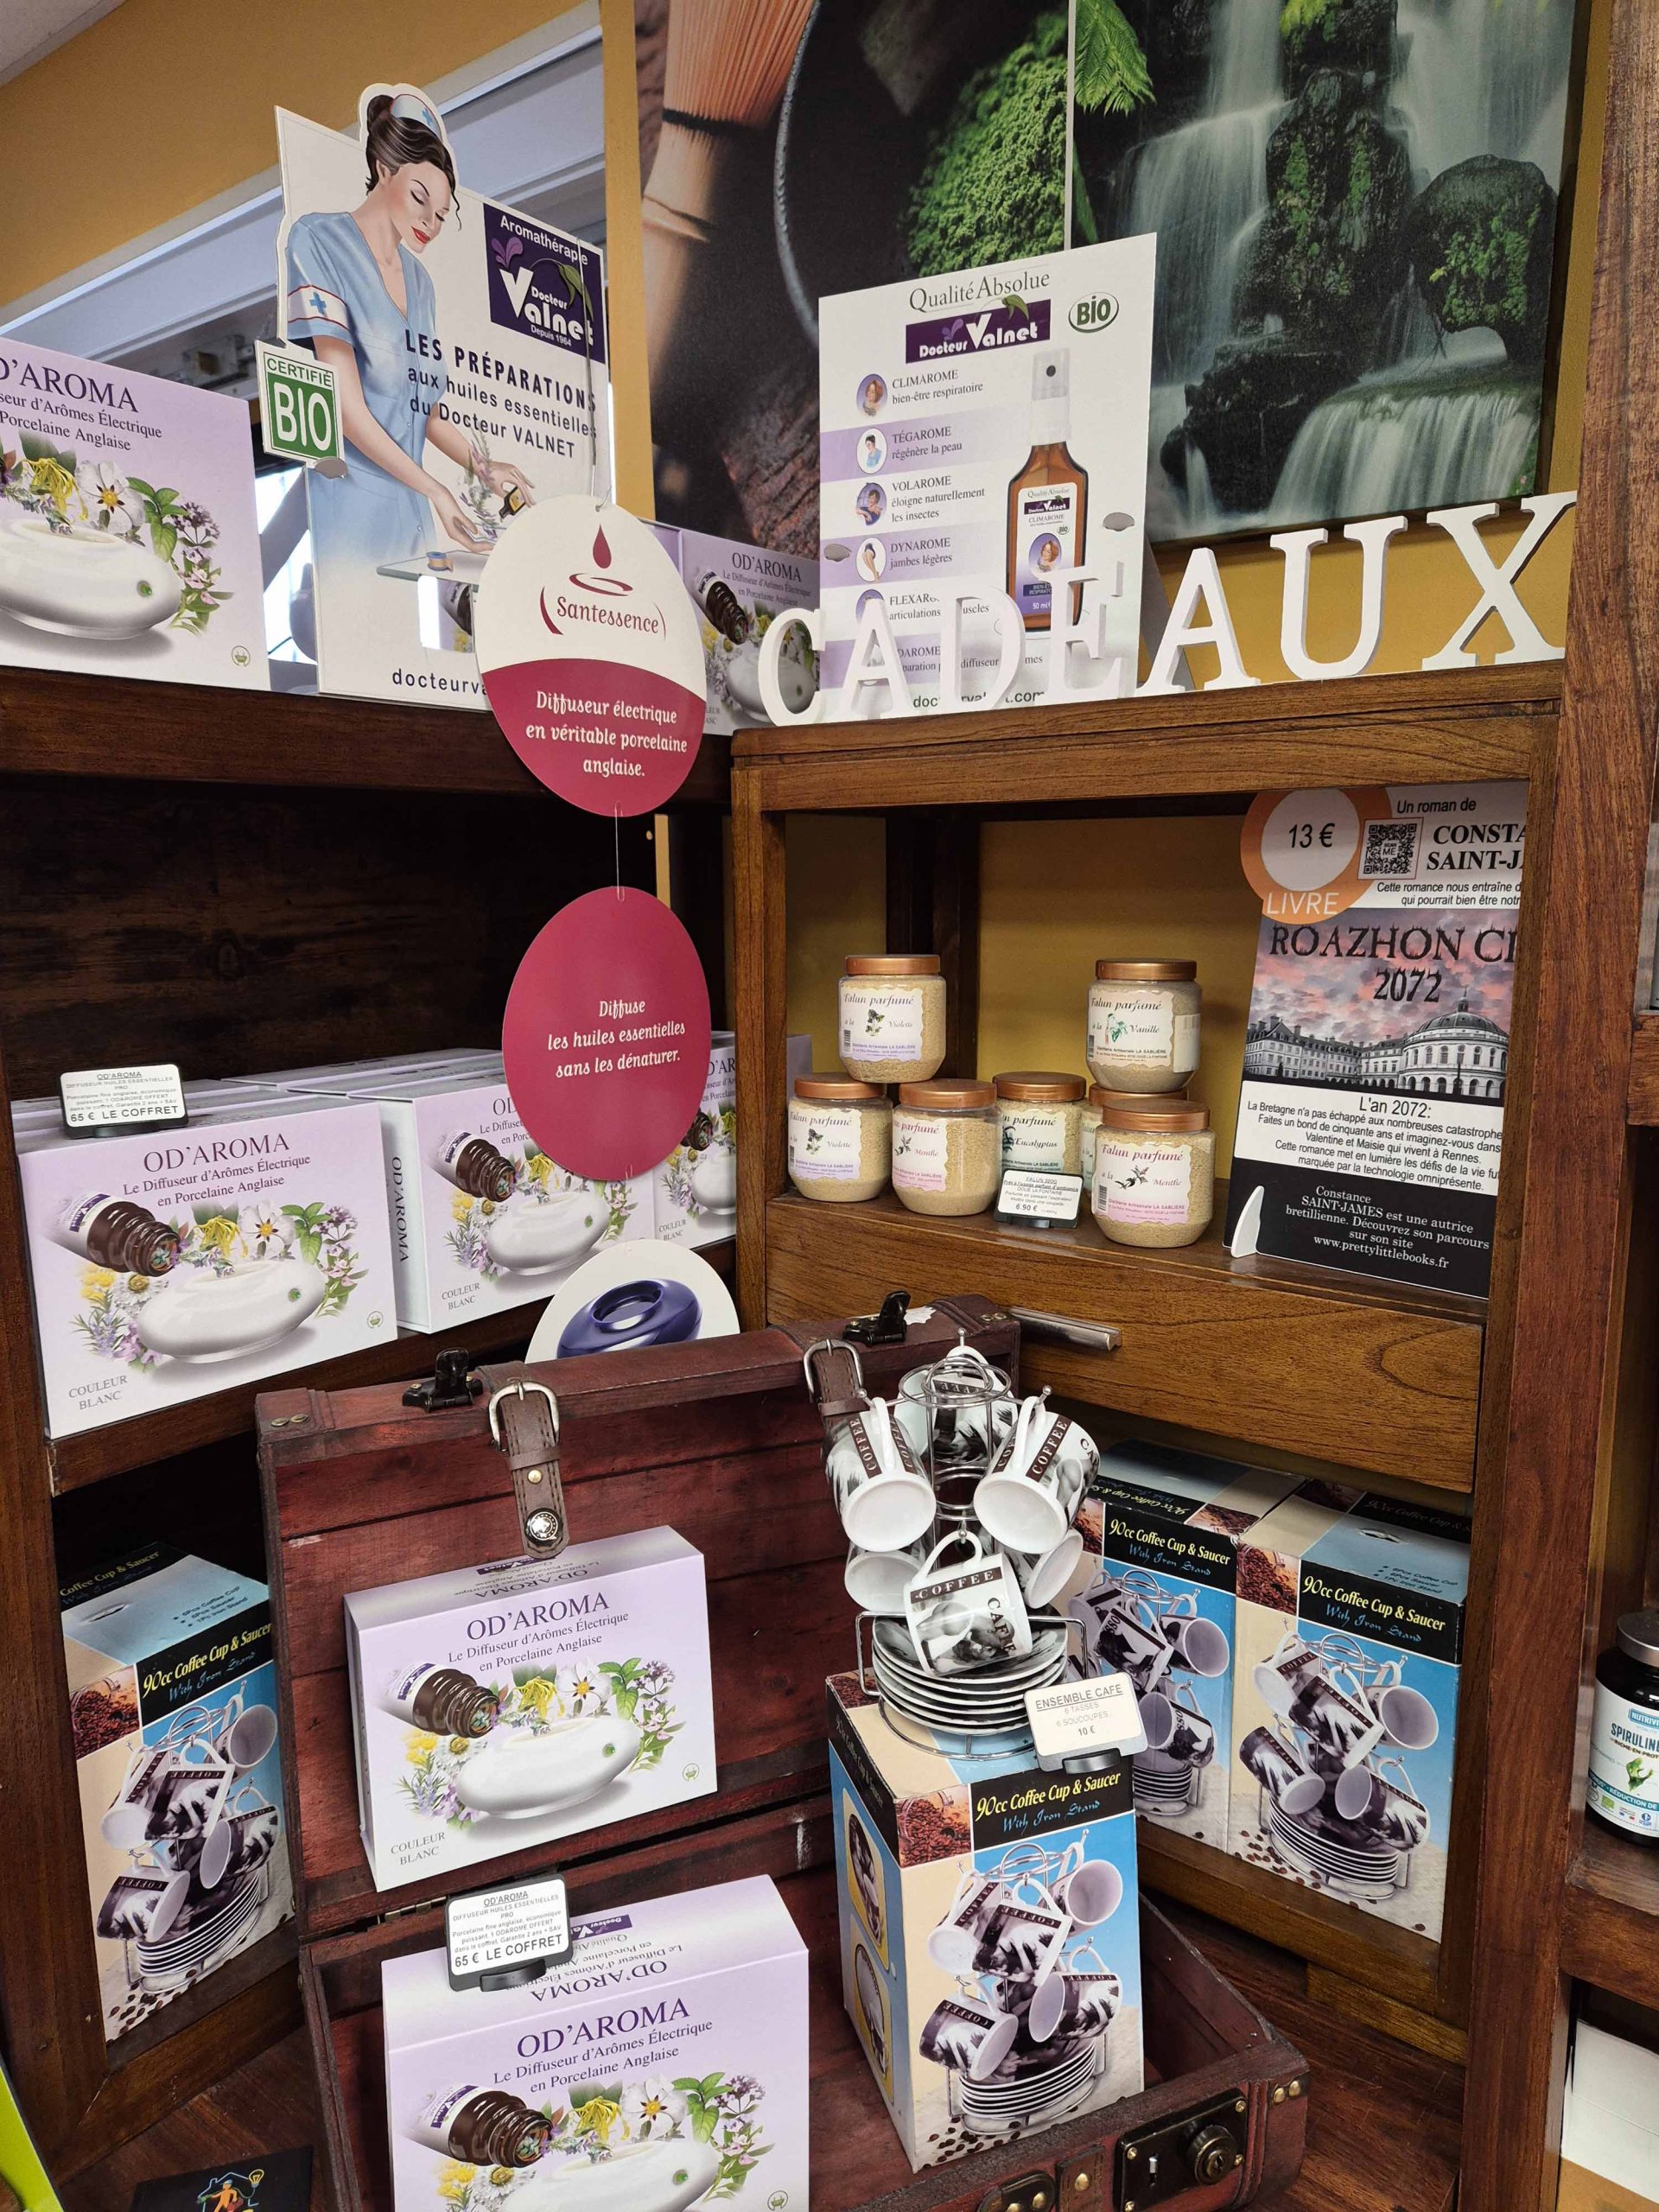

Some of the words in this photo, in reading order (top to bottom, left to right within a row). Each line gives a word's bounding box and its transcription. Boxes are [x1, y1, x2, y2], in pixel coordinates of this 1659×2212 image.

[531, 286, 568, 310] Docteur
[909, 282, 975, 313] Qualité
[977, 271, 1051, 299] Absolue
[531, 325, 554, 340] Depuis
[556, 334, 571, 346] 1964
[919, 340, 968, 358] Docteur
[966, 313, 1038, 349] Valnet
[267, 357, 333, 388] CERTIFIÉ
[405, 329, 442, 361] LES
[454, 346, 596, 413] PRÉPARATIONS
[892, 369, 959, 389] CLIMAROME
[408, 367, 439, 389] aux
[446, 375, 498, 408] huiles
[892, 389, 931, 404] bien-être
[932, 382, 983, 401] respiratoire
[0, 410, 71, 438] Porcelaine
[75, 429, 131, 451] Anglaise
[31, 397, 94, 423] d'Arômes
[98, 410, 162, 439] Électrique
[273, 383, 331, 451] BIO
[410, 396, 430, 416] du
[439, 403, 507, 437] Docteur
[513, 425, 575, 459] VALNET
[892, 426, 951, 443] TÉGAROME
[892, 444, 929, 460] régénère
[931, 443, 939, 454] la
[941, 441, 963, 456] peau
[891, 495, 923, 510] éloigne
[925, 488, 985, 505] naturellement
[892, 476, 951, 493] VOLAROME
[892, 512, 903, 524] les
[906, 508, 939, 521] insectes
[890, 537, 951, 554] DYNAROME
[732, 552, 801, 582] OD'AROMA
[890, 555, 920, 571] jambes
[922, 552, 952, 567] légères
[556, 596, 660, 634] Santessence
[757, 491, 1579, 727] CADEAUX
[536, 690, 610, 717] Diffuseur
[613, 701, 677, 724] électrique
[525, 723, 545, 740] en
[550, 726, 617, 747] véritable
[620, 733, 688, 753] porcelaine
[582, 757, 646, 778] anglaise.
[1396, 799, 1414, 813] Un
[1417, 800, 1457, 813] roman
[1459, 797, 1477, 811] de
[1288, 823, 1313, 849] 13
[1319, 823, 1335, 849] €
[1376, 882, 1402, 893] Cette
[1403, 883, 1440, 893] romance
[1442, 883, 1470, 893] nous
[1471, 881, 1512, 893] entraîne
[1402, 895, 1415, 907] qui
[1417, 894, 1454, 906] pourrait
[1456, 894, 1477, 906] bien
[1478, 894, 1498, 906] être
[1267, 892, 1339, 915] LIVRE
[1269, 923, 1465, 961] ROAZHON
[1374, 967, 1442, 1002] 2072
[599, 999, 645, 1019] Diffuse
[548, 1034, 568, 1050] les
[573, 1030, 614, 1048] huiles
[619, 1020, 686, 1042] essentielles
[556, 1062, 590, 1077] sans
[594, 1057, 613, 1073] les
[617, 1050, 681, 1069] dénaturer.
[71, 1113, 84, 1122] 65
[103, 1110, 117, 1119] LE
[121, 1106, 178, 1117] COFFRET
[1359, 1096, 1388, 1115] L'an
[1391, 1099, 1432, 1118] 2072:
[143, 1133, 290, 1173] OD'AROMA
[1132, 1150, 1183, 1163] parfumé
[124, 1182, 140, 1196] Le
[143, 1173, 198, 1193] Diffuseur
[200, 1164, 255, 1182] d'Arômes
[257, 1157, 310, 1173] Électrique
[156, 1195, 172, 1207] en
[175, 1184, 234, 1205] Porcelaine
[237, 1175, 284, 1193] Anglaise
[1316, 1185, 1371, 1204] Constance
[391, 1156, 410, 1264] OD'AROMA
[1301, 1195, 1383, 1217] SAINT-JAMES
[1386, 1211, 1402, 1221] est
[1406, 1215, 1427, 1225] une
[1431, 1218, 1474, 1234] autrice
[1286, 1205, 1349, 1225] bretillienne.
[1352, 1216, 1410, 1236] Découvrez
[1413, 1229, 1433, 1240] son
[1436, 1231, 1490, 1249] parcours
[1349, 1230, 1368, 1241] sur
[1370, 1234, 1389, 1245] son
[1393, 1236, 1414, 1249] site
[1313, 1235, 1449, 1269] www.prettylittlebooks.fr
[68, 1374, 128, 1398] COULEUR
[79, 1390, 121, 1410] BLANC
[1109, 1519, 1135, 1539] 90cc
[1136, 1529, 1166, 1548] Coffee
[1167, 1538, 1186, 1555] Cup
[1188, 1543, 1196, 1555] &
[1198, 1546, 1230, 1566] Saucer
[918, 1570, 995, 1600] COFFEE
[466, 1591, 610, 1640] OD'AROMA
[1302, 1575, 1332, 1598] 90cc
[1335, 1588, 1369, 1608] Coffee
[1371, 1599, 1393, 1618] Cup
[1395, 1605, 1404, 1619] &
[1406, 1610, 1446, 1631] Saucer
[448, 1651, 463, 1662] Le
[467, 1637, 518, 1660] Diffuseur
[521, 1625, 574, 1645] d'Arômes
[575, 1611, 629, 1634] Électrique
[142, 1669, 173, 1699] 90cc
[175, 1656, 207, 1681] Coffee
[209, 1643, 230, 1663] Cup
[230, 1635, 239, 1652] &
[241, 1622, 272, 1646] Saucer
[1035, 1689, 1092, 1709] ENSEMBLE
[1095, 1683, 1122, 1697] CAFE
[1078, 1727, 1088, 1736] 10
[976, 1796, 1007, 1822] 90cc
[1010, 1789, 1046, 1810] Coffee
[1048, 1784, 1071, 1802] Cup
[1072, 1779, 1082, 1795] &
[1084, 1773, 1121, 1792] Saucer
[454, 1955, 468, 1967] 65
[473, 1953, 479, 1963] €
[486, 1948, 501, 1961] LE
[505, 1934, 563, 1956] COFFRET
[517, 1997, 690, 2058] OD'AROMA
[494, 2070, 512, 2084] Le
[516, 2054, 578, 2080] Diffuseur
[582, 2040, 645, 2063] d'Arômes
[648, 2019, 713, 2046] Électrique
[531, 2081, 546, 2094] en
[550, 2063, 620, 2090] Porcelaine
[622, 2047, 680, 2072] Anglaise
